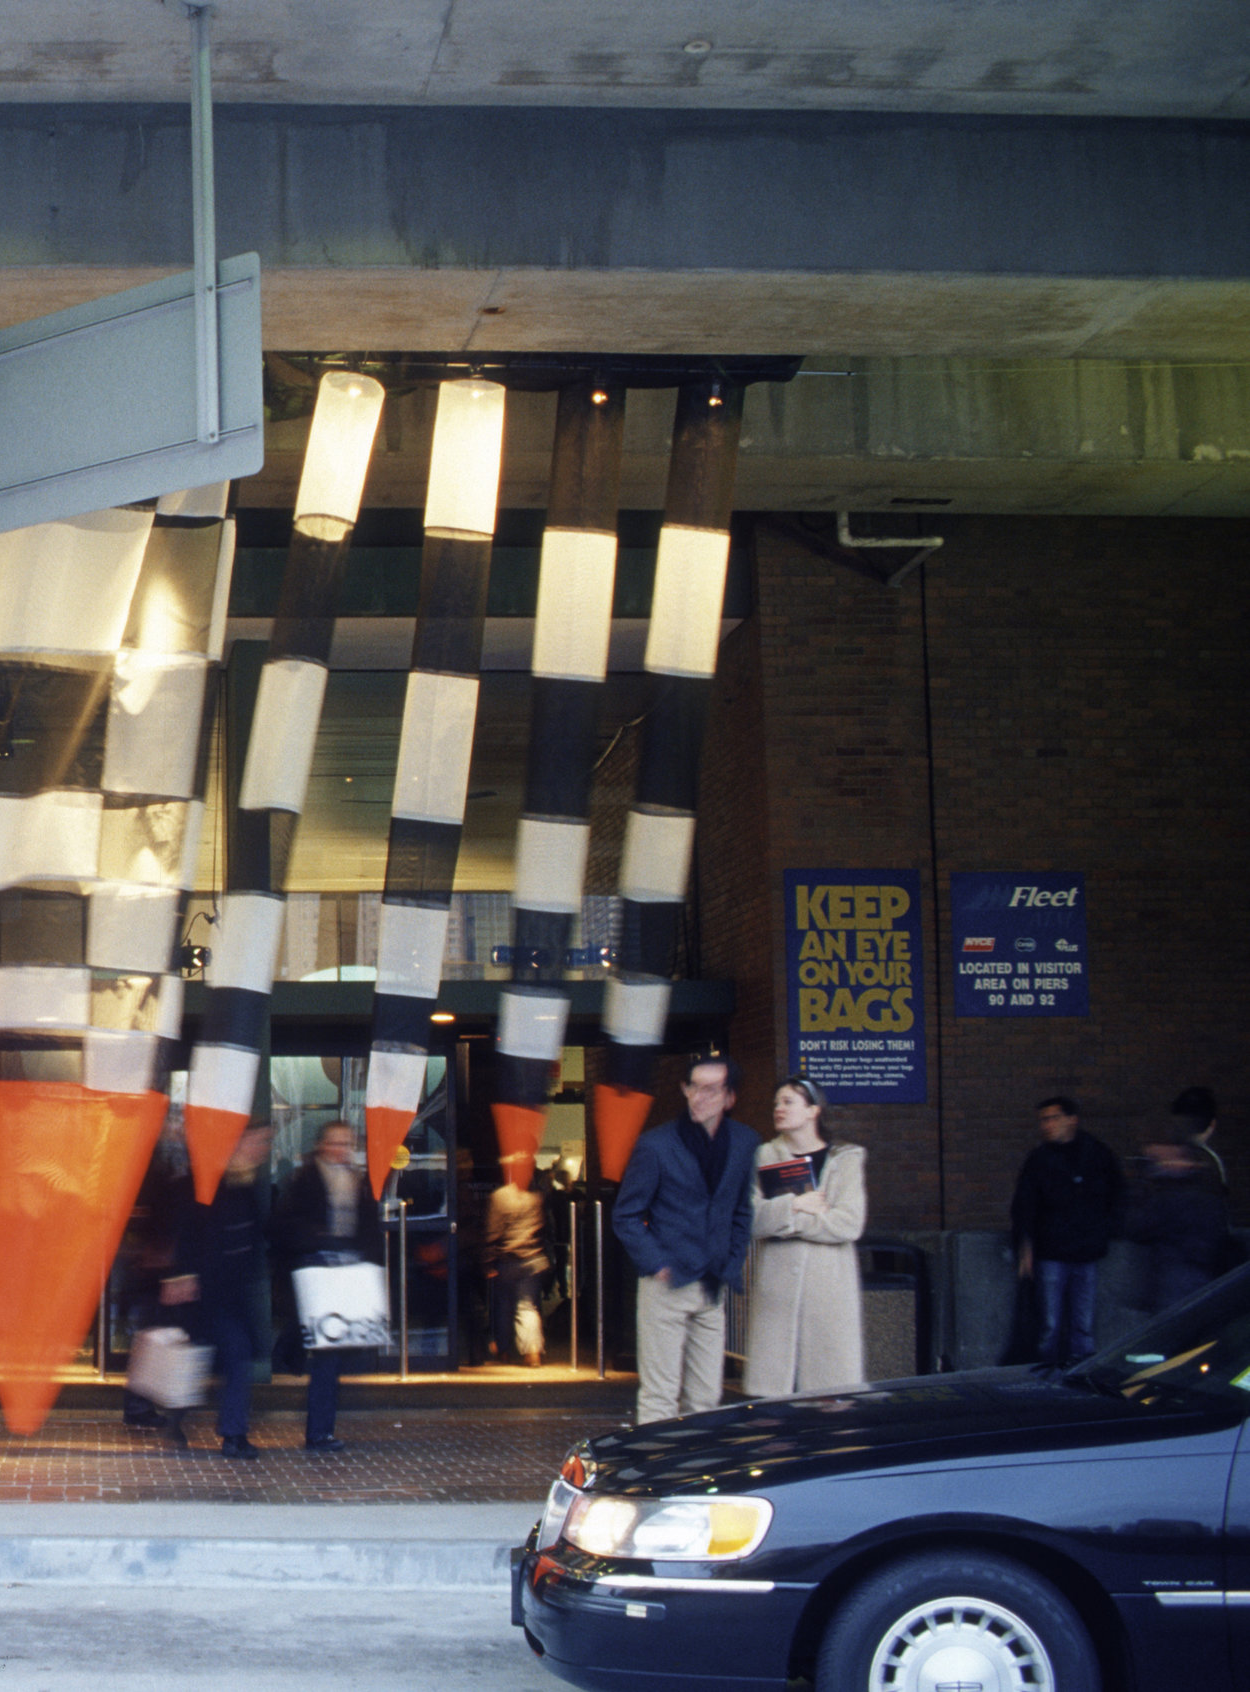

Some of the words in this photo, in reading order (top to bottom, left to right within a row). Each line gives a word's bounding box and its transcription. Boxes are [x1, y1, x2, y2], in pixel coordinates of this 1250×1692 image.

[1008, 886, 1079, 907] Fleet
[796, 885, 911, 930] KEEP
[798, 930, 847, 960] AN
[856, 930, 912, 960] EYE
[798, 960, 840, 986] ON
[844, 960, 913, 986] YOUR
[958, 962, 1013, 974] LOCATED
[1017, 962, 1030, 974] IN
[1034, 962, 1082, 974] VISITOR
[974, 978, 1007, 990] AREA
[1012, 978, 1030, 990] ON
[1034, 978, 1069, 990] PIERS
[799, 987, 915, 1033] BAGS
[988, 994, 1005, 1005] 90
[1010, 994, 1035, 1005] AND
[1040, 994, 1055, 1005] 92
[799, 1040, 828, 1051] DON'T
[830, 1040, 849, 1051] RISK
[852, 1040, 885, 1051] LOSING
[887, 1040, 915, 1051] THEM!
